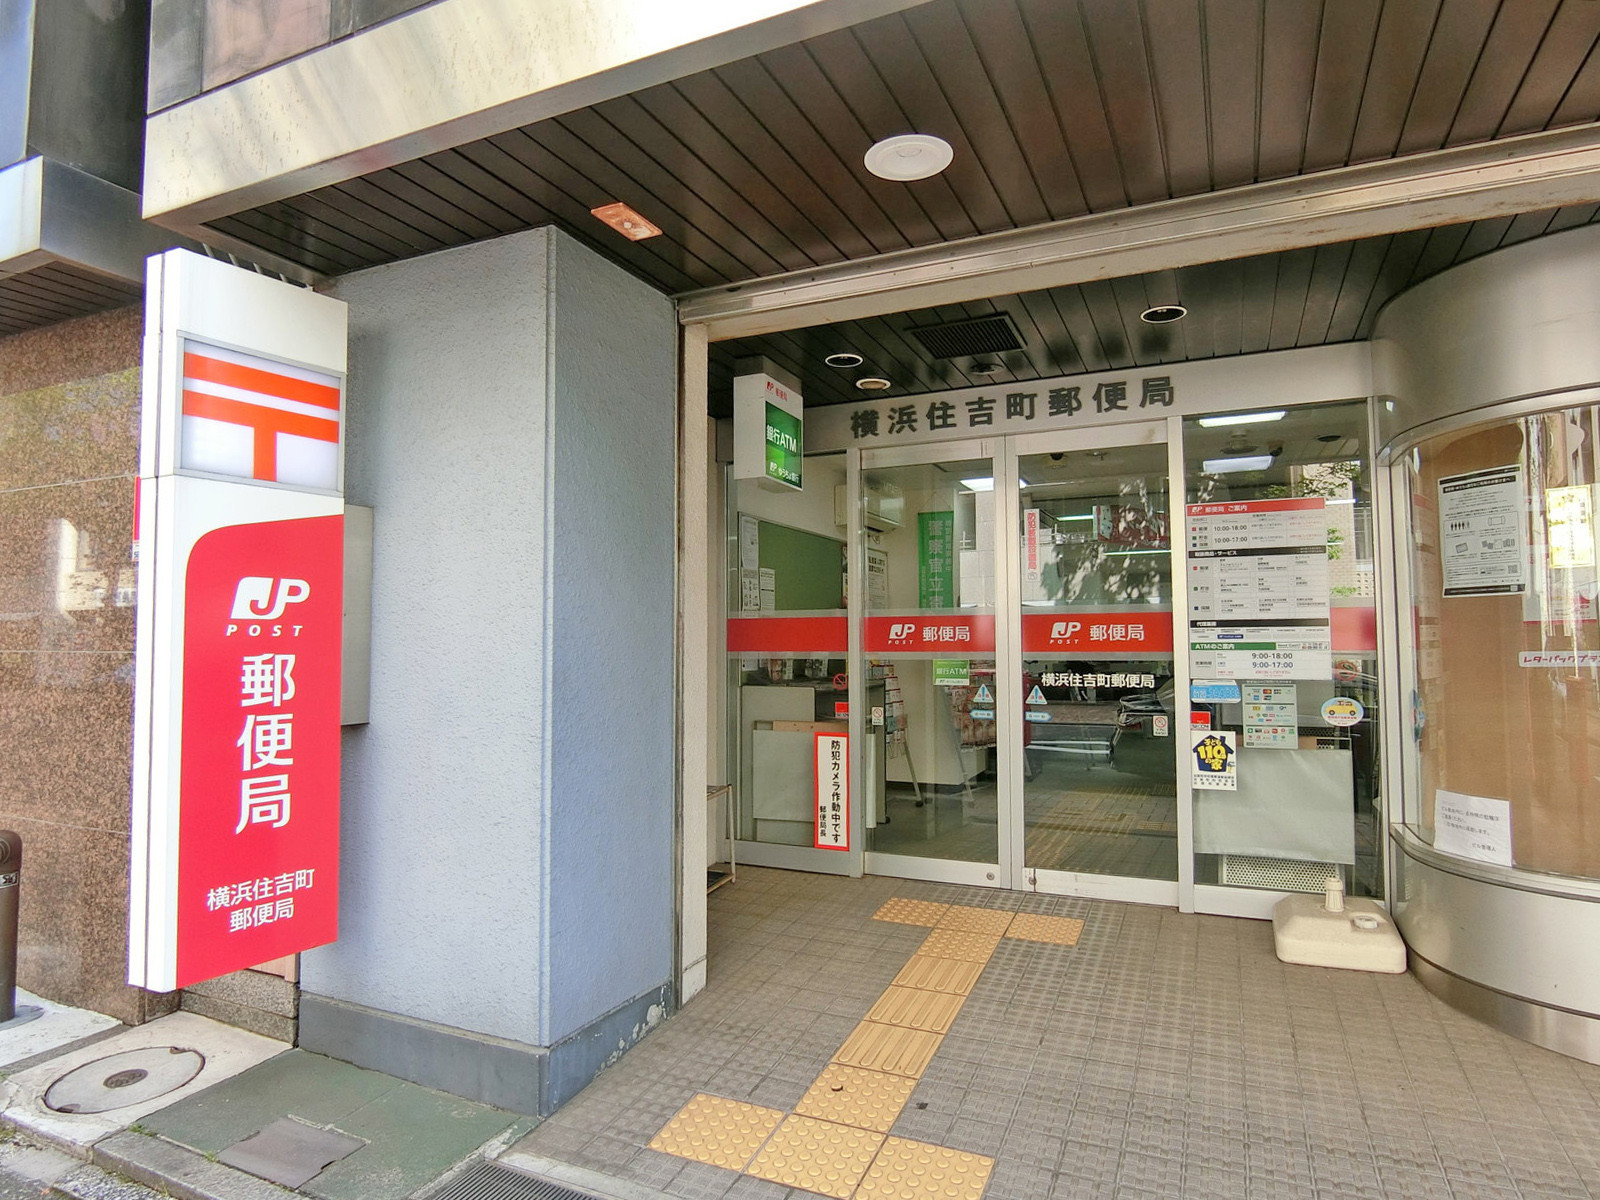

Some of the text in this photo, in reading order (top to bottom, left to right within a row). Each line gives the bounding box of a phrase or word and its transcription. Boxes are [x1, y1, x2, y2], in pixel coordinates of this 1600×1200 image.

[850, 376, 1175, 439] 横浜住吉町郵便局
[766, 424, 797, 453] 銀行ATM
[1214, 524, 1248, 532] 10:00-18:00
[1214, 536, 1248, 544] 10:00-17:00
[225, 624, 304, 637] POST
[922, 626, 970, 643] 郵便局
[1089, 624, 1145, 642] 郵便局
[1251, 652, 1293, 660] 9:00-18:00
[936, 667, 967, 675] 銀行ATM
[1252, 661, 1294, 669] 9:00-17:00
[1041, 673, 1155, 689] 横浜住吉町郵便局
[235, 653, 296, 835] 郵便局
[831, 740, 841, 843] 防犯カメラ作動中です
[819, 805, 827, 837] 郵便局長
[207, 868, 316, 911] 横浜住吉町
[229, 898, 295, 933] 郵便局
